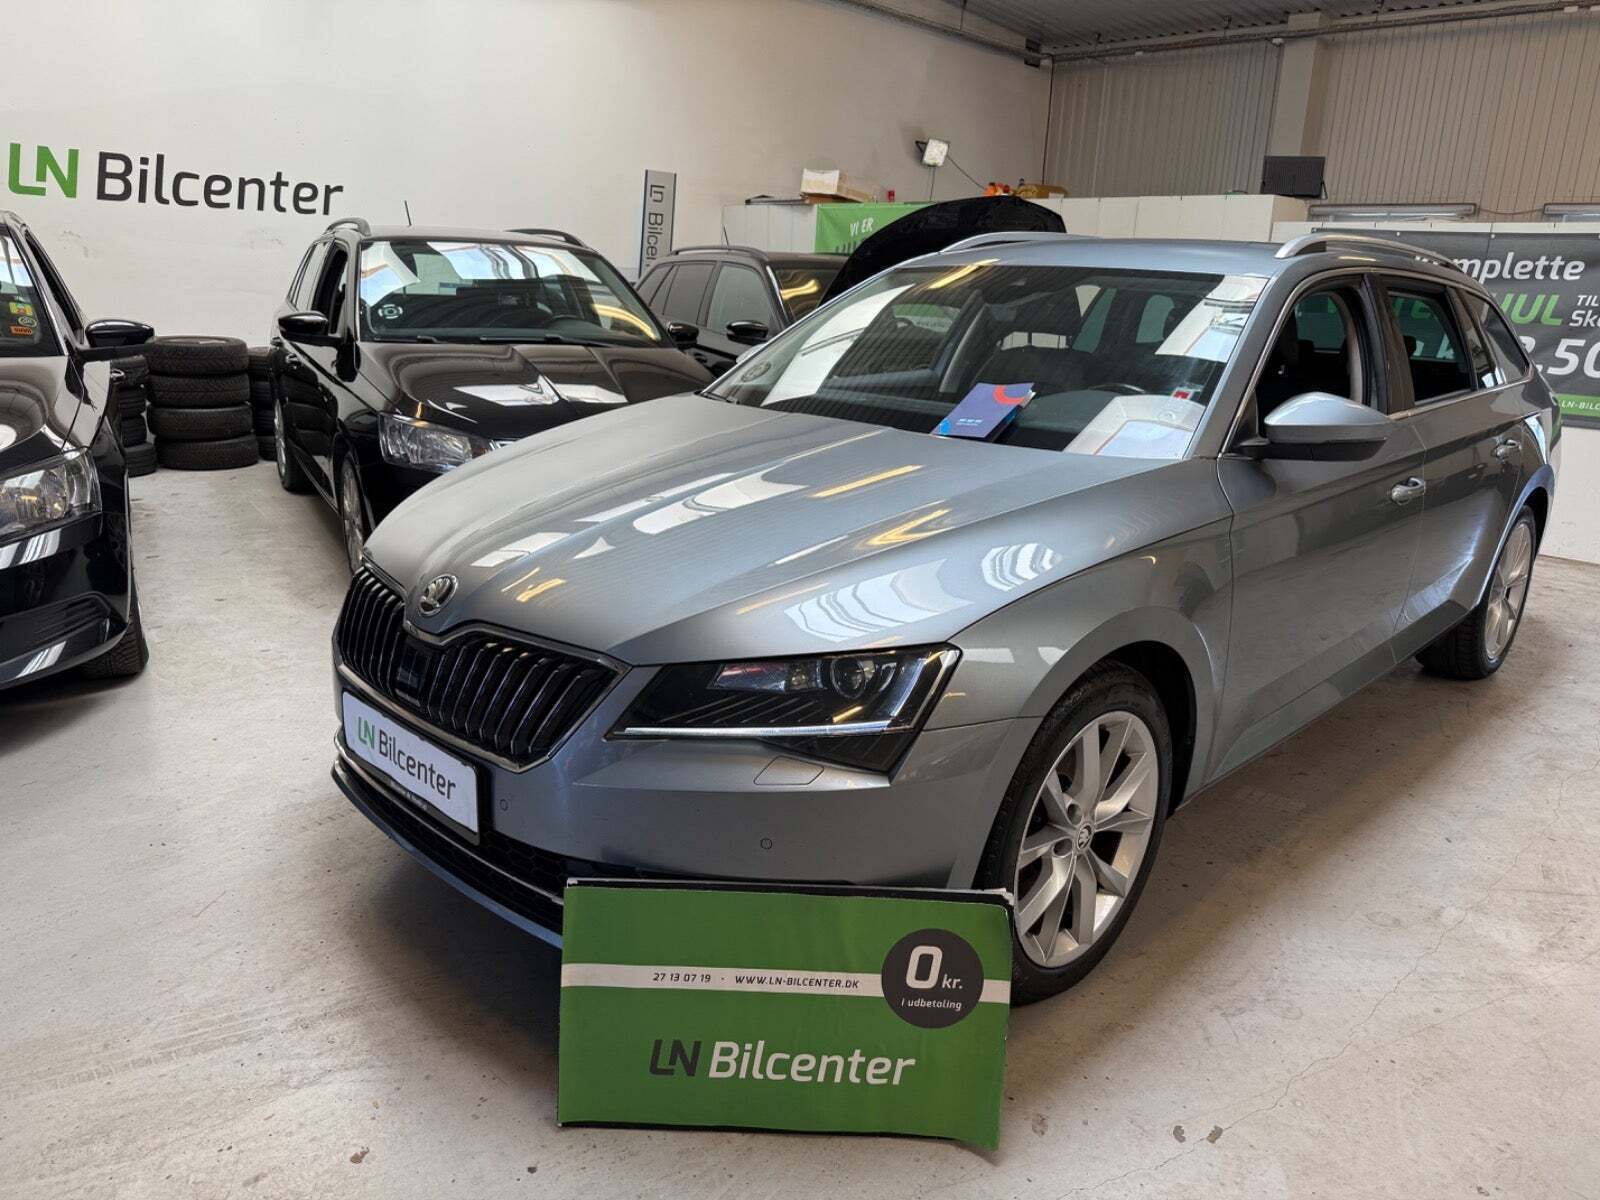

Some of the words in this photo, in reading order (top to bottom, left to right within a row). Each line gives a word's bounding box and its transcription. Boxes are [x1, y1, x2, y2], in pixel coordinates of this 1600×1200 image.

[8, 142, 80, 199] LN
[96, 151, 345, 216] Bilcenter
[1453, 251, 1586, 285] mplette
[1576, 295, 1600, 307] TIL
[1568, 309, 1600, 328] Sk
[357, 716, 376, 750] LN
[379, 729, 457, 800] Bilcenter
[652, 972, 667, 982] 27
[669, 972, 681, 982] 13
[683, 973, 697, 983] 07
[700, 974, 712, 983] 19
[735, 975, 860, 989] WWW.LN-BILCENTER.DK
[905, 945, 943, 989] 0
[941, 973, 963, 990] kr.
[907, 998, 962, 1012] udbetaling
[649, 1038, 702, 1077] LN
[708, 1039, 916, 1086] Bilcenter
